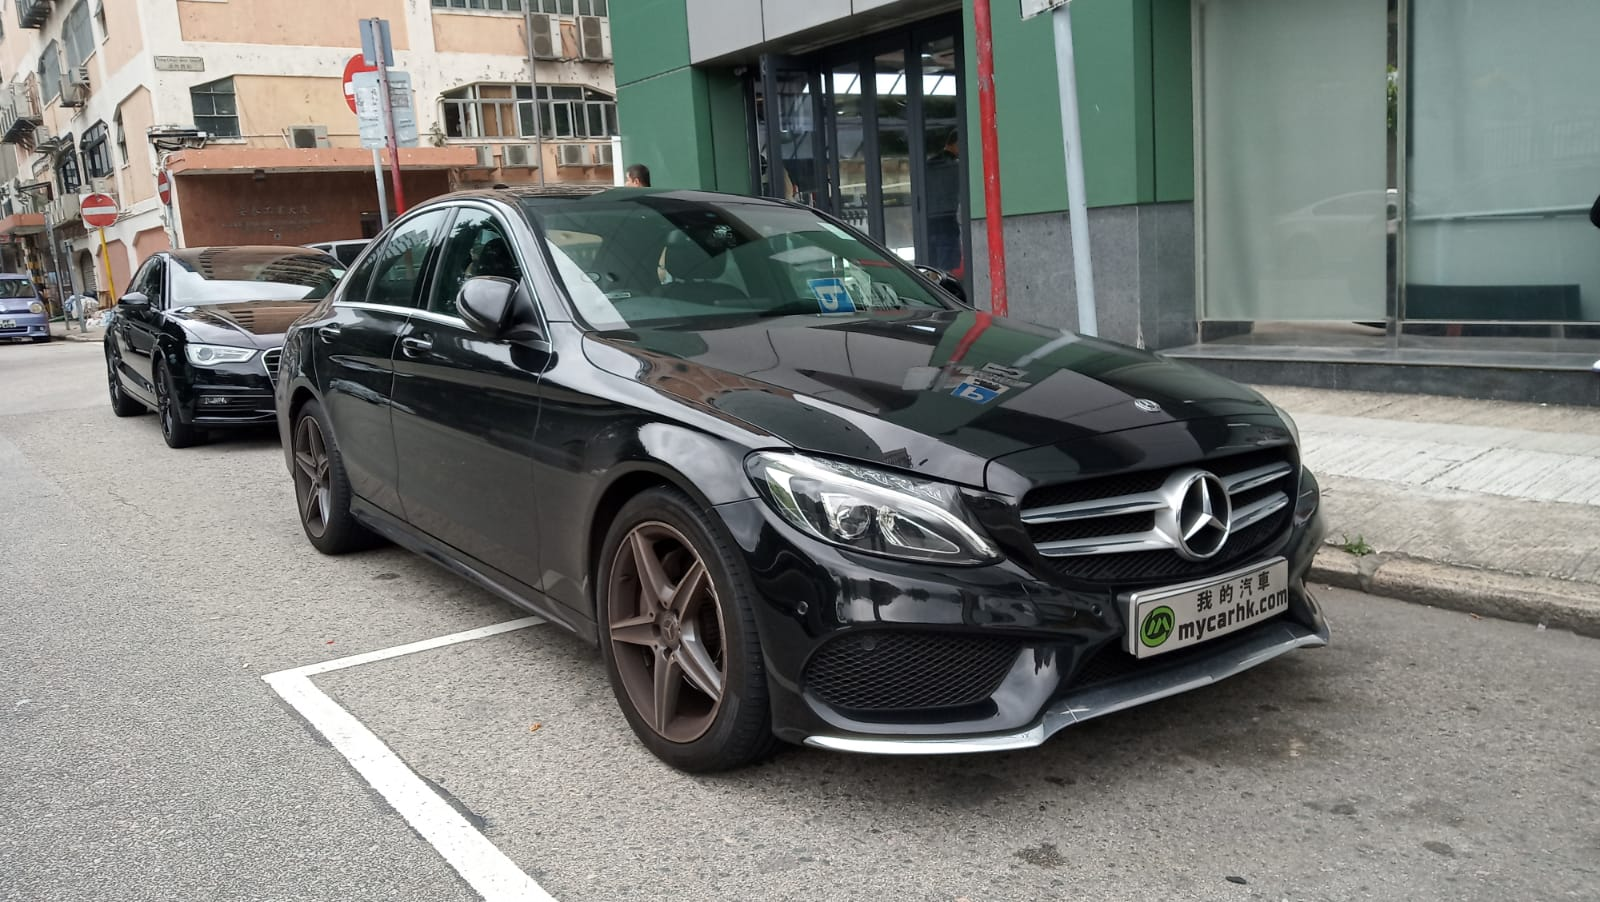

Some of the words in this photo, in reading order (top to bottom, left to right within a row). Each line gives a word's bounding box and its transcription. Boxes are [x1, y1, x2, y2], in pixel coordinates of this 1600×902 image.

[1178, 588, 1288, 641] mycarhk.com
[1196, 570, 1270, 613] 我的汽車
